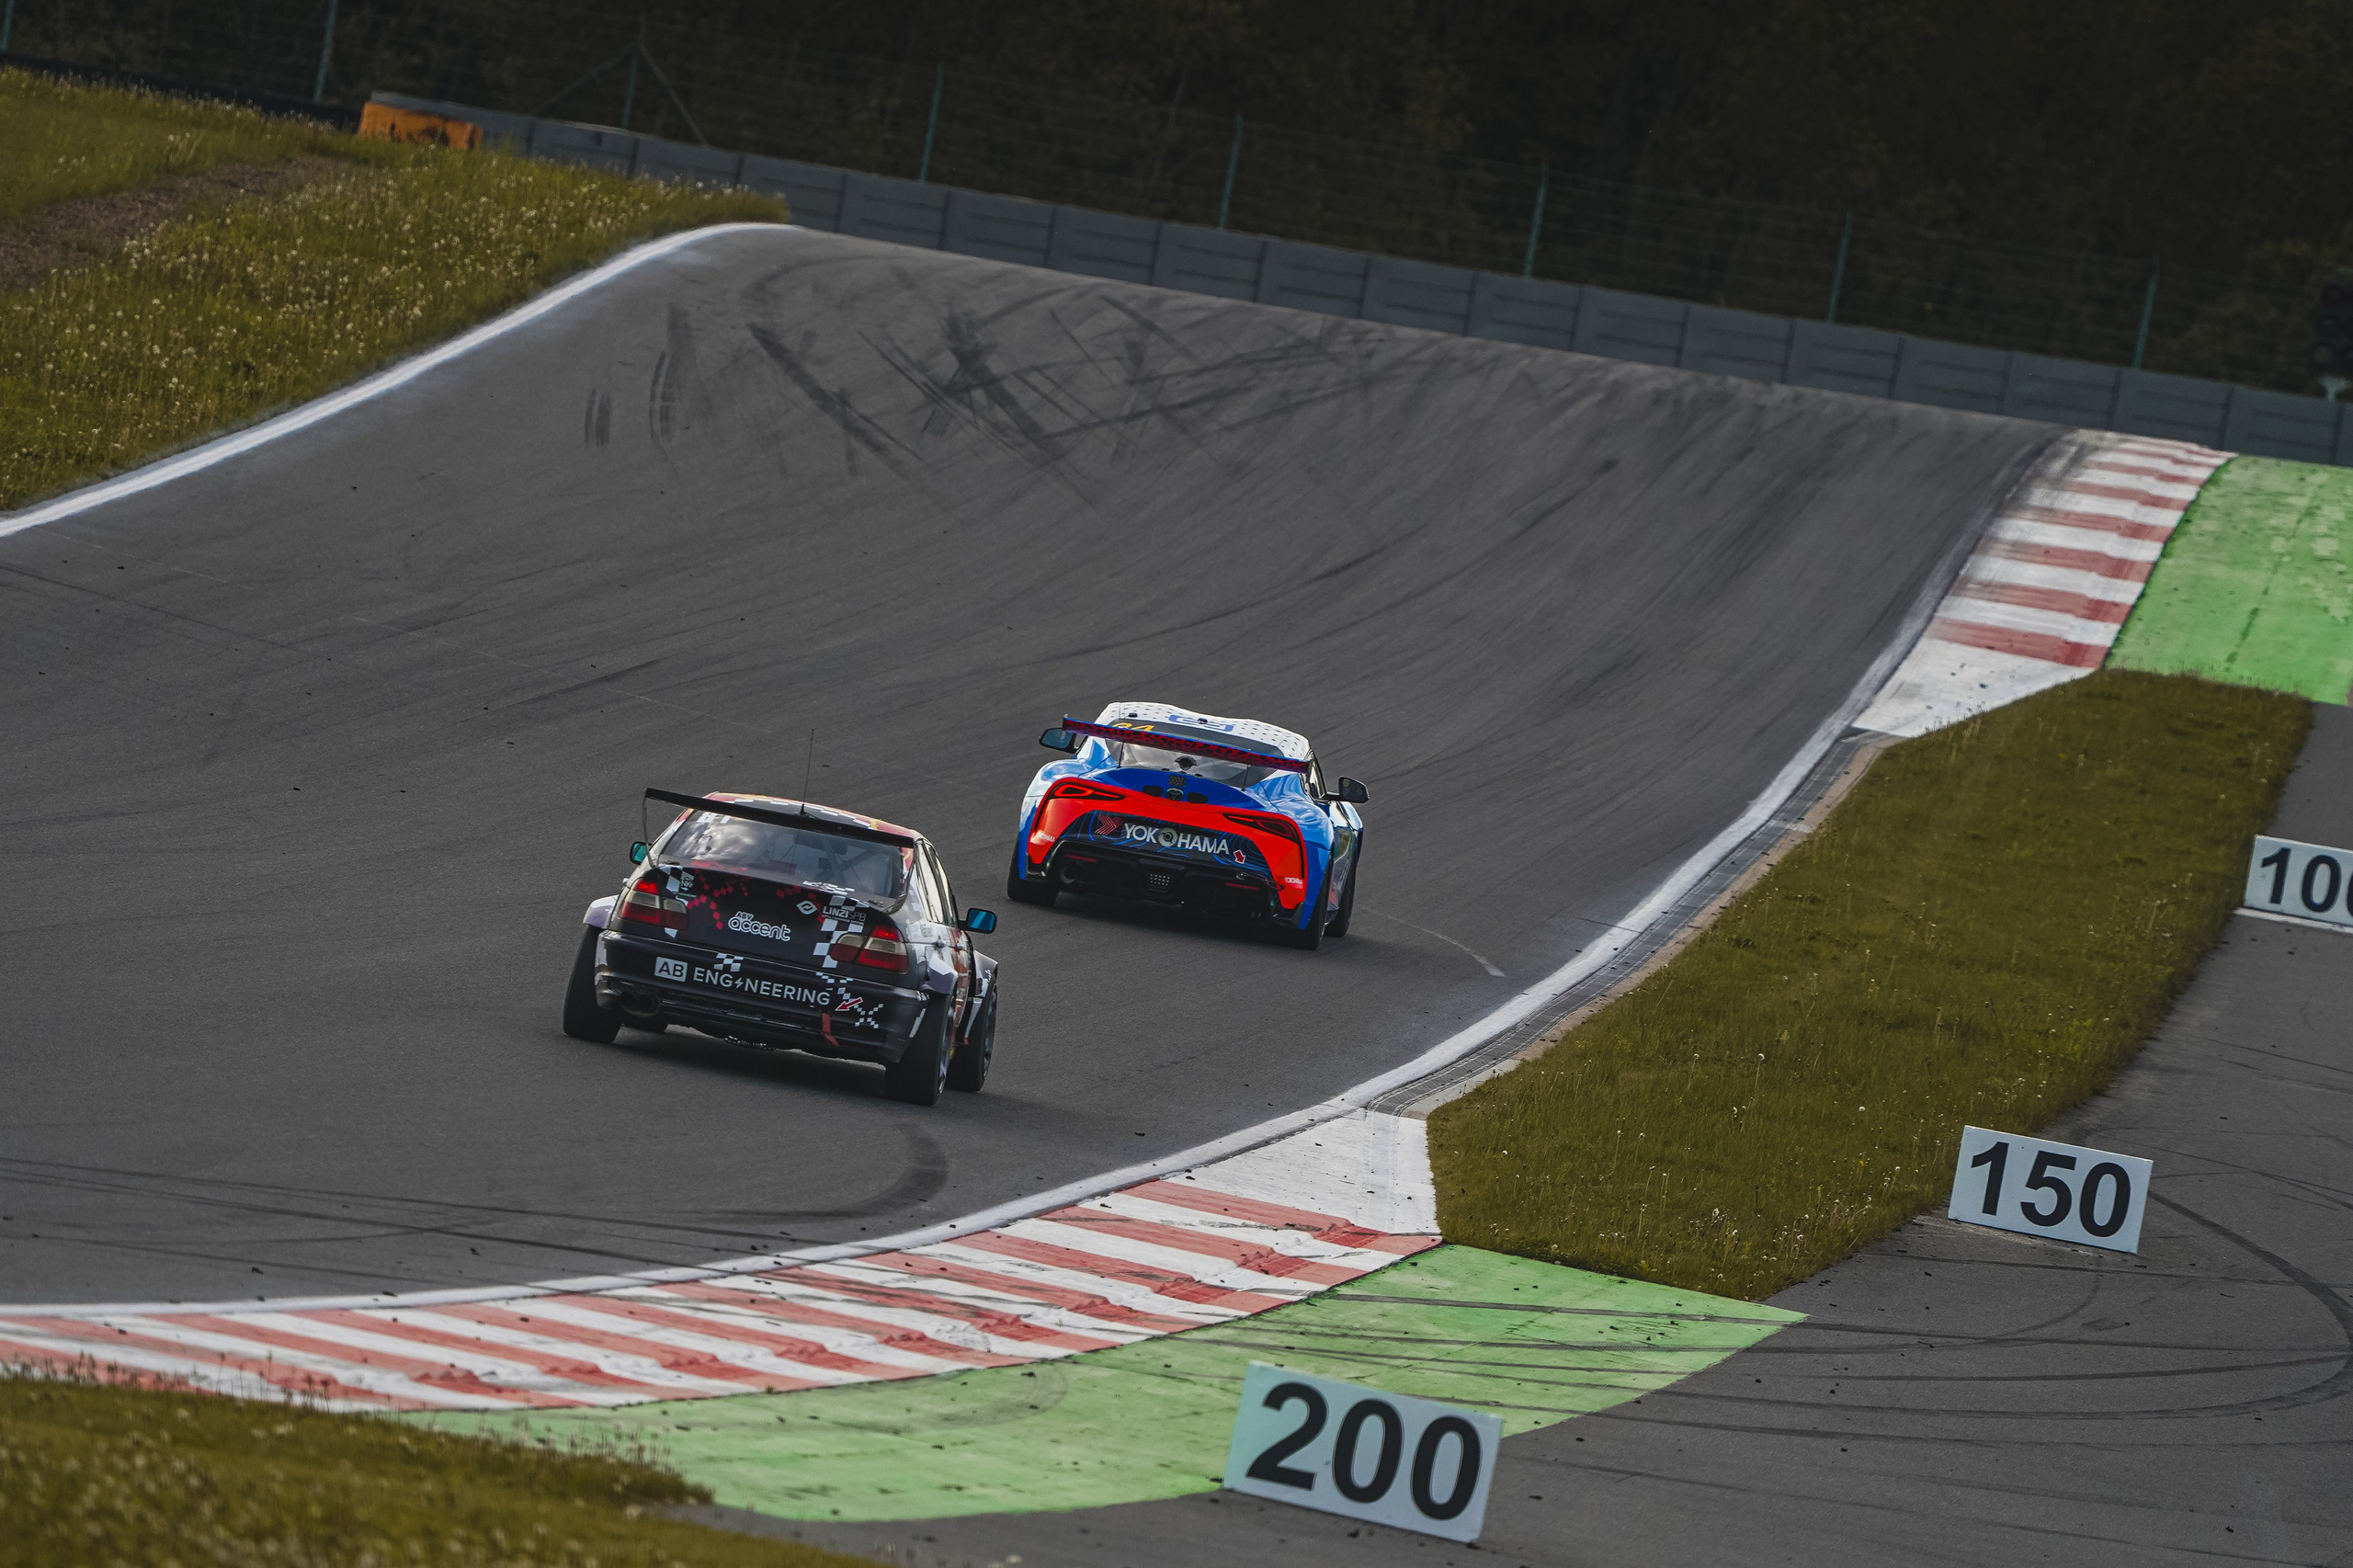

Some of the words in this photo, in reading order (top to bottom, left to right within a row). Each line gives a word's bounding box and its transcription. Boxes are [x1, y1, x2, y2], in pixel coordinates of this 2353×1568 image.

[1124, 823, 1230, 855] YOKOHAMA
[2261, 847, 2353, 916] 10
[823, 906, 849, 918] LINZI
[728, 916, 791, 941] accent
[657, 960, 685, 979] AB
[1971, 1141, 2131, 1238] 150
[1245, 1381, 1483, 1521] 200
